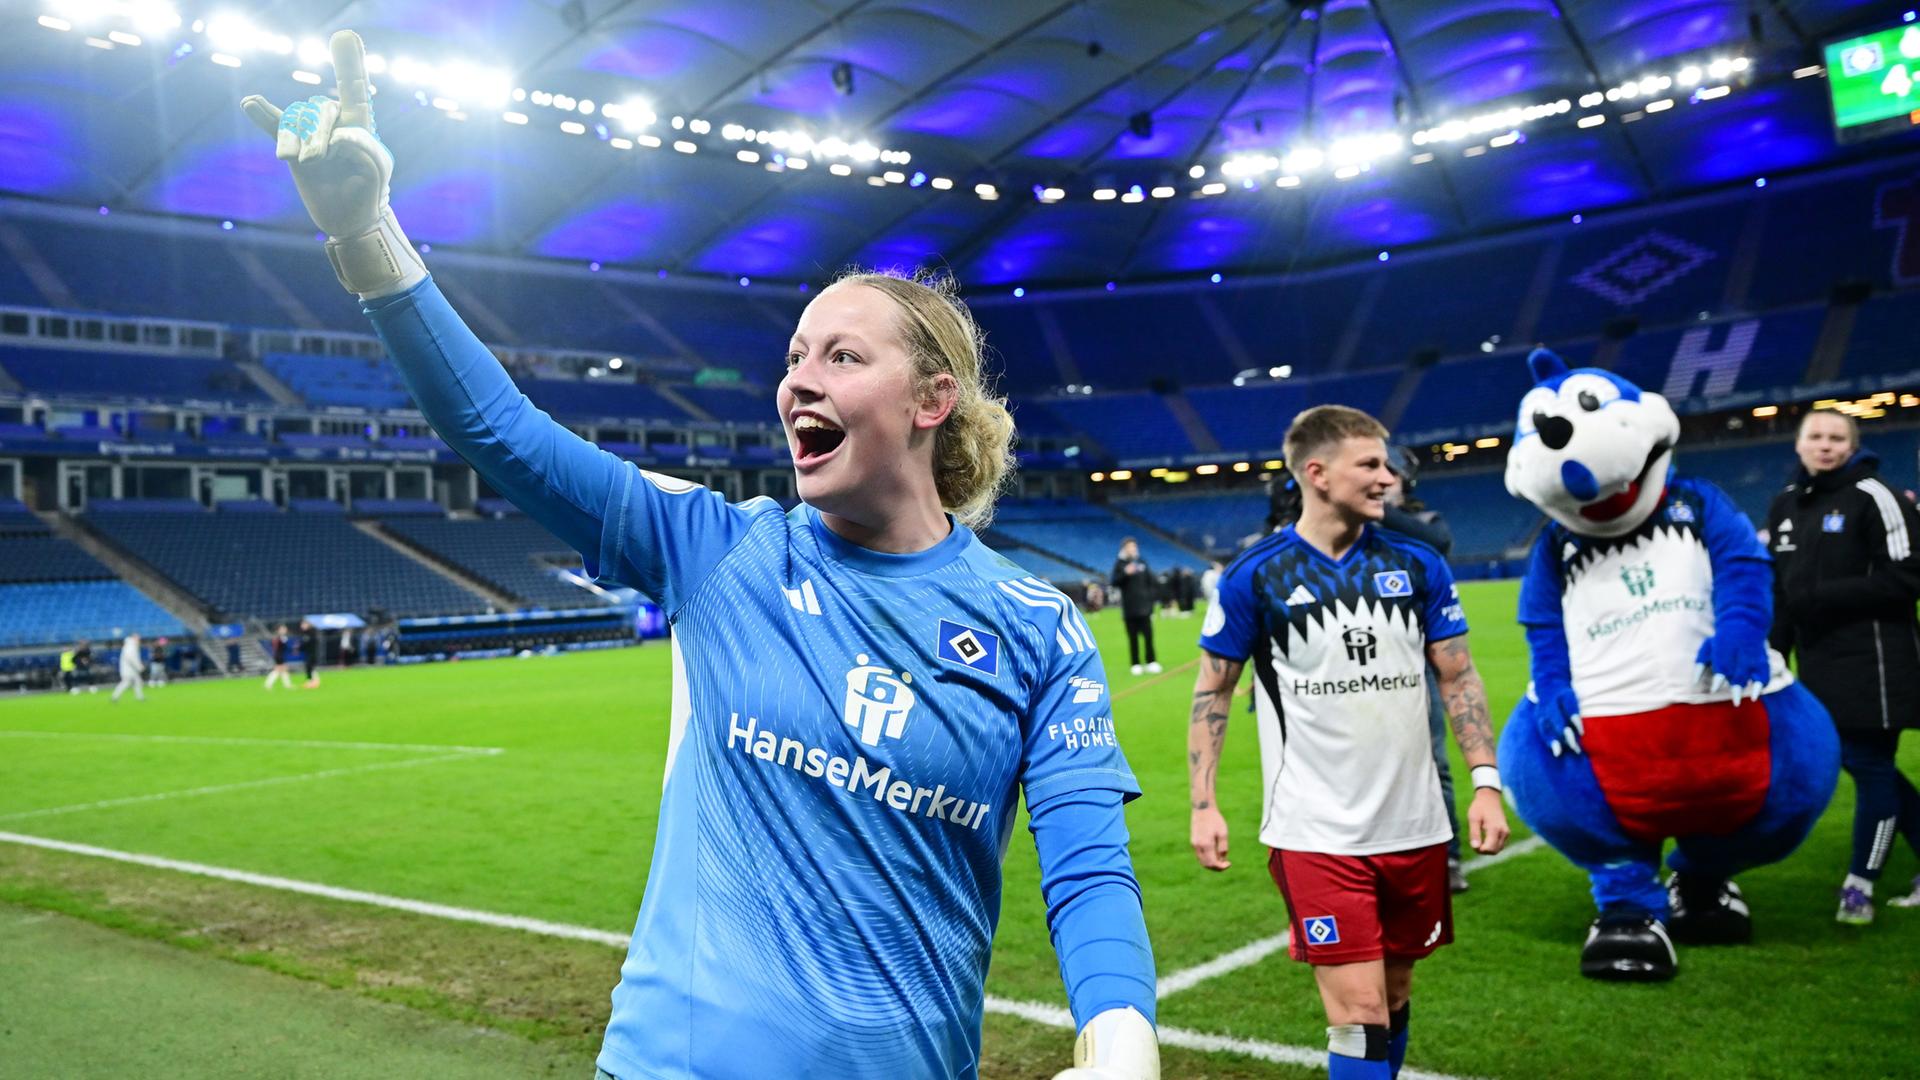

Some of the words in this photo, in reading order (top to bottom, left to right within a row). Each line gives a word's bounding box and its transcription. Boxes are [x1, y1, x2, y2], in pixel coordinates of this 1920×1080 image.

[1662, 318, 1761, 399] H
[1587, 595, 1705, 641] HanseMerku
[1294, 673, 1421, 695] HanseMerkur
[1048, 717, 1115, 740] FLOATIN
[727, 712, 990, 830] HanseMerkur
